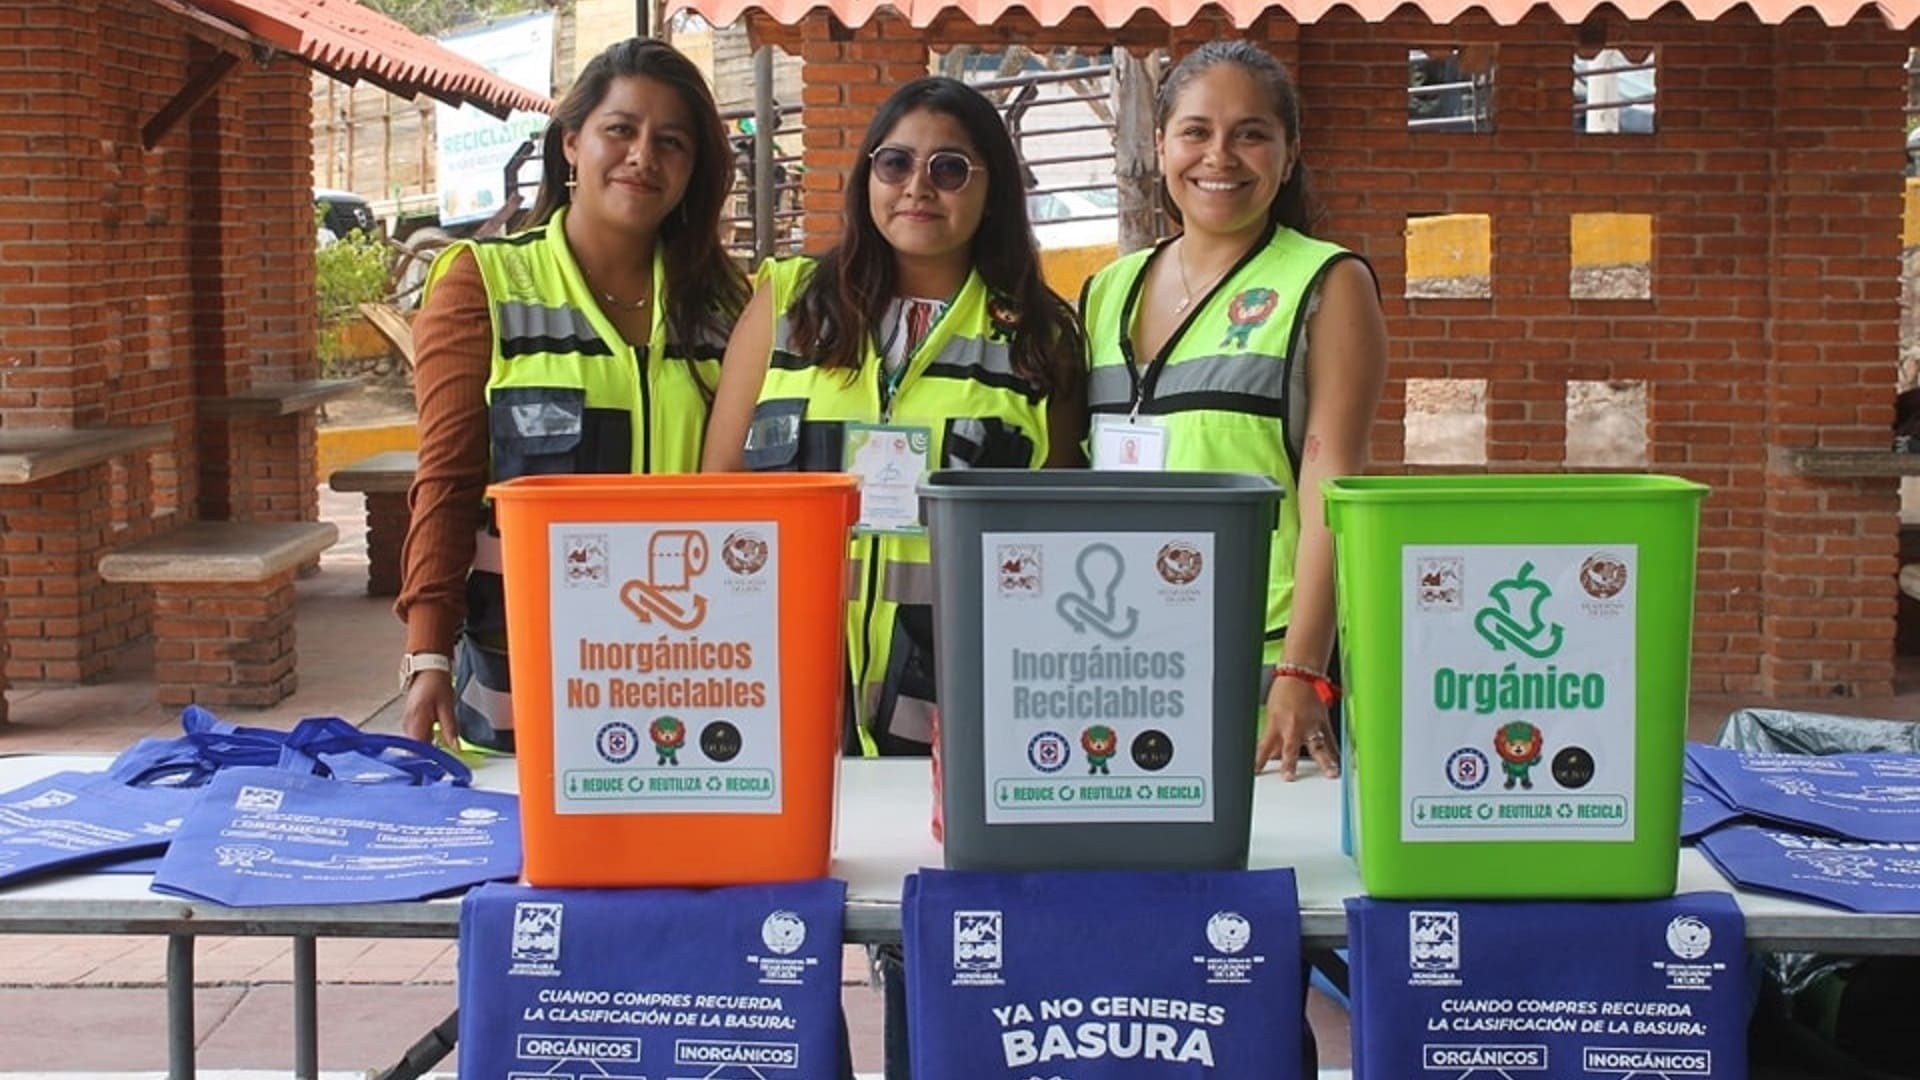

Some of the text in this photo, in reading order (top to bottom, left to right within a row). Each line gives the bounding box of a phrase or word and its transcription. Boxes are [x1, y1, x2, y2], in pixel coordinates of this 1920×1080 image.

[579, 635, 752, 673] Inorgánicos
[1011, 644, 1186, 682] Inorgánicos
[567, 677, 767, 708] No Reciclables
[1433, 662, 1606, 715] Orgánico
[1012, 684, 1185, 720] Reciclables
[582, 777, 771, 793] REDUCE REUTILIZA RECICLA
[1013, 786, 1201, 801] REDUCE REUTILIZA RECICLA
[1430, 804, 1623, 820] REDUCE REUTILIZA RECICLA
[538, 989, 783, 1011] CUANDO COMPRES RECUERDA
[1441, 999, 1692, 1017] CUANDO COMPRES RECUERDA
[523, 1006, 796, 1030] LA CLASIFICACIÓN DE LA BASURA:
[993, 996, 1226, 1027] YA NO GENERES
[1427, 1014, 1707, 1036] LA CLASIFICACIÓN DE LA BASURA:
[526, 1038, 633, 1058] ORGÁNICOS
[680, 1044, 794, 1064] INORGÁNICOS
[1002, 1022, 1215, 1067] BASURA
[1432, 1047, 1539, 1066] ORGÁNICOS
[1588, 1051, 1706, 1070] INORGÁNICOS
